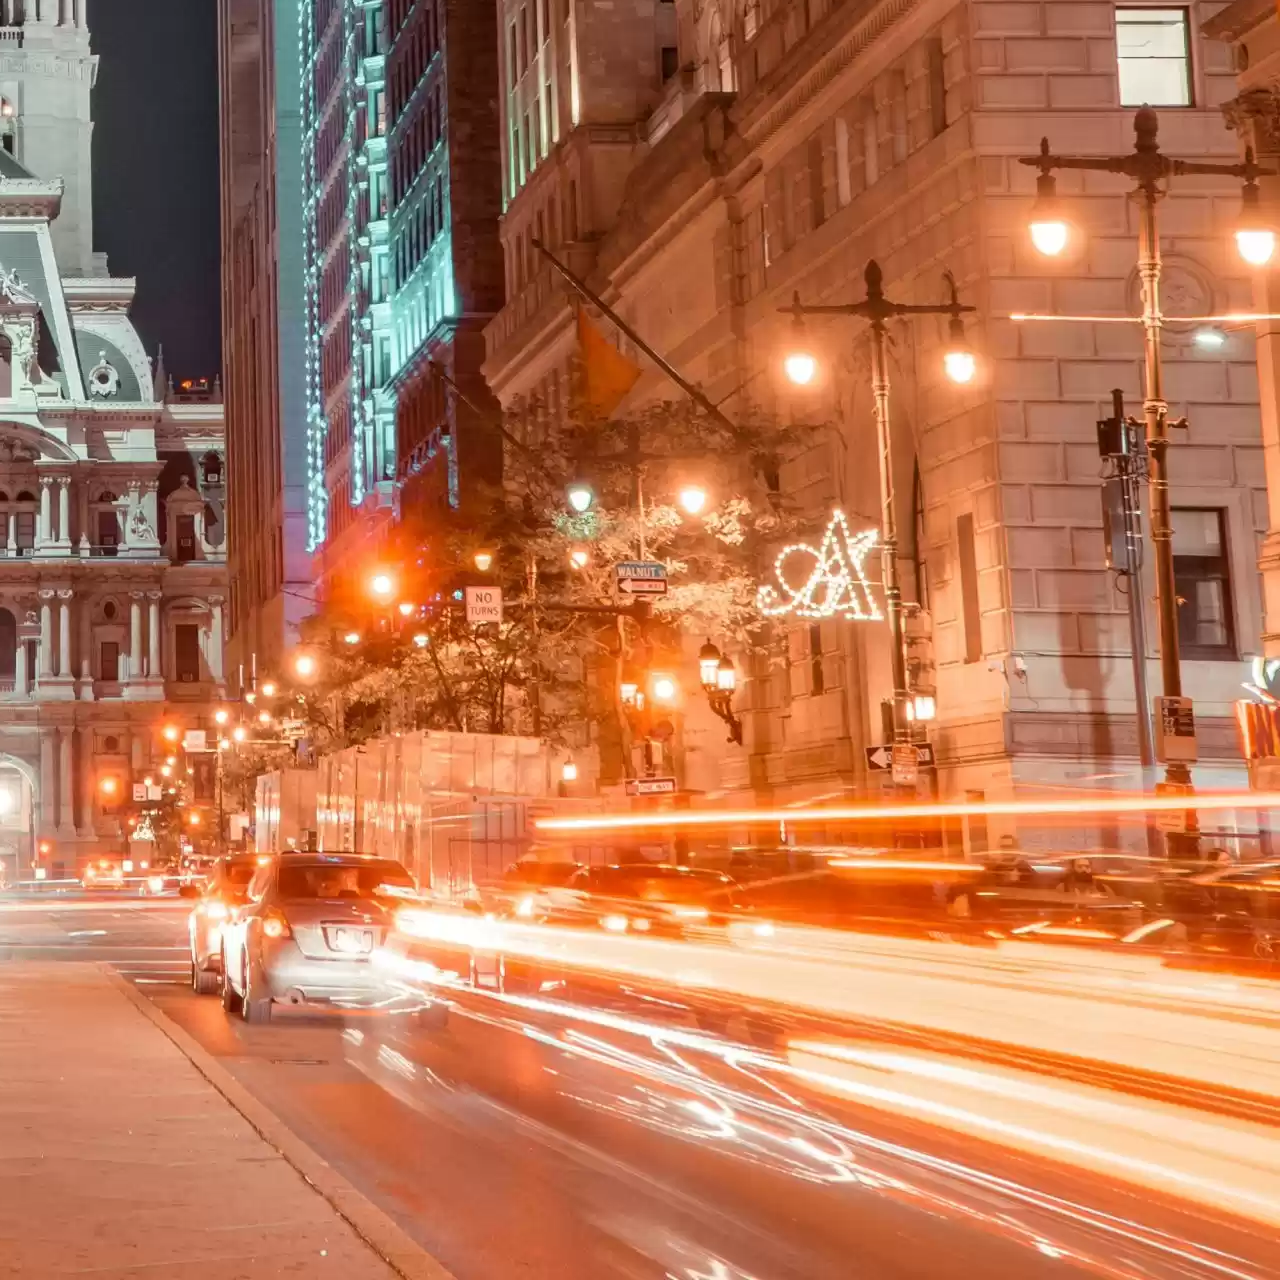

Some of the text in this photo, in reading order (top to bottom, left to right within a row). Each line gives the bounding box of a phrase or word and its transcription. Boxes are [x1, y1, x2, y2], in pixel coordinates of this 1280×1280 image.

[617, 567, 657, 577] WALNUT
[475, 592, 492, 603] NO
[470, 606, 499, 617] TURNS
